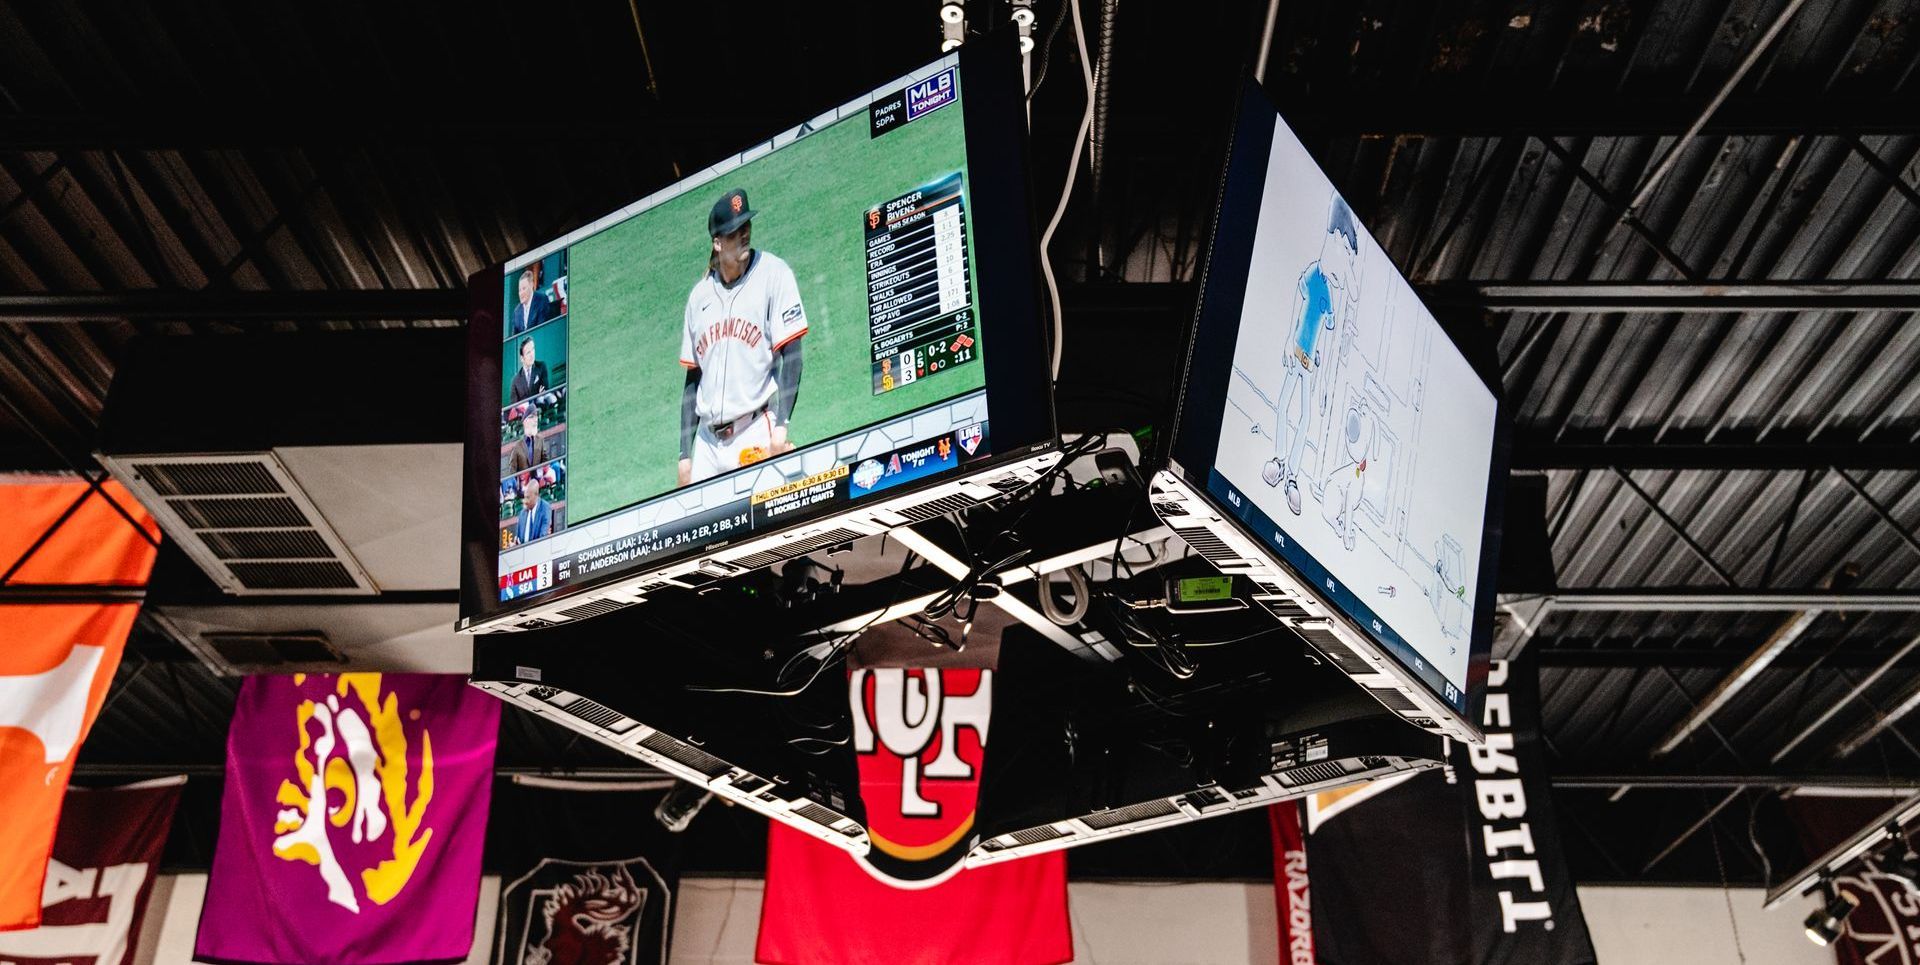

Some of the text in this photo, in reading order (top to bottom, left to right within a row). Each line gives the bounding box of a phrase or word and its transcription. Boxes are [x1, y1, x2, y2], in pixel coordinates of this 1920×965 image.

[910, 73, 951, 104] MLB
[911, 89, 952, 112] TONIGHT
[875, 100, 902, 118] PADRES
[876, 114, 896, 128] SDPA
[886, 191, 922, 212] SPENCER
[886, 204, 916, 221] BIVENS
[888, 212, 926, 232] THIS SEASON
[869, 234, 891, 248] GAMES
[869, 244, 896, 259] RECORD
[870, 260, 884, 270] ERA
[870, 265, 897, 280] INNINGS
[871, 272, 910, 292] STRIKEOUTS
[872, 289, 894, 303] WALKS
[872, 294, 913, 314] HR ALLOWED
[873, 309, 900, 324] OPP AVG
[955, 312, 968, 321] 0-2
[710, 318, 762, 348] FRANCISCO
[874, 324, 892, 336] WHIP
[880, 331, 914, 348] BOGAERTS
[875, 346, 899, 360] BIVENS
[928, 340, 947, 356] 0-2
[904, 354, 911, 365] 0
[917, 358, 924, 368] 5
[904, 370, 912, 381] 3
[960, 426, 980, 440] LIVE
[901, 446, 936, 464] TONIGHT
[912, 458, 918, 468] 7
[770, 488, 779, 497] ON
[780, 482, 798, 492] MLBN
[802, 476, 816, 486] 6:30
[823, 470, 836, 480] 9:30
[838, 467, 846, 476] ET
[764, 480, 836, 509] NATIONALS AT PHILLIES
[1228, 490, 1241, 508] MLB
[774, 500, 801, 516] ROCKIES
[802, 497, 810, 507] AT
[810, 490, 835, 504] GIANTS
[578, 513, 748, 575] TY. ANDERSON (LAA): 4.1 IP, 3 H, 2 ER, 2 BB, 3 K
[578, 529, 658, 563] SCHANUEL (LAA): 1-2, R
[705, 540, 729, 552] Hisense
[1274, 531, 1285, 548] NFL
[542, 564, 548, 574] 3
[558, 560, 571, 572] BOT
[518, 568, 533, 582] LAA
[542, 576, 548, 587] 3
[518, 580, 534, 595] SEA
[1445, 681, 1458, 704] FS1
